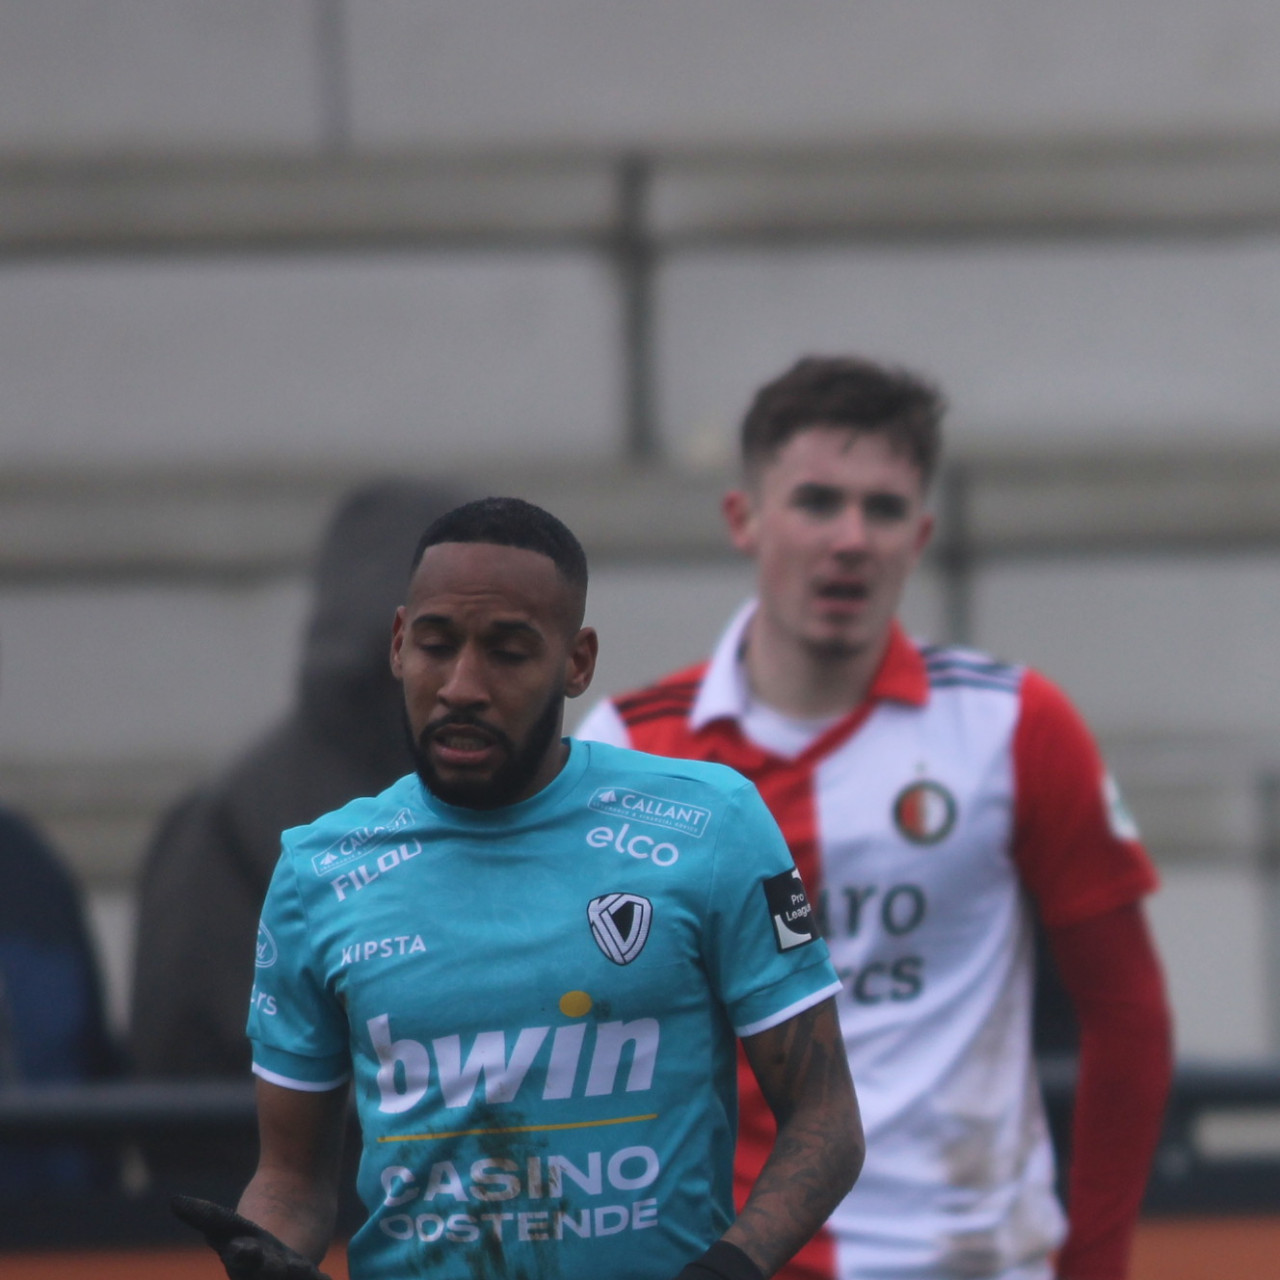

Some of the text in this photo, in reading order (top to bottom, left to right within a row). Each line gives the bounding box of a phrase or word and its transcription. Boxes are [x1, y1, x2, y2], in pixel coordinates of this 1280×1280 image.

[622, 794, 706, 825] CALLANT
[340, 811, 407, 856] CALLT
[586, 823, 679, 867] elco
[330, 838, 422, 902] FILOU
[786, 903, 812, 922] Leagu
[791, 892, 805, 904] Pro
[340, 934, 426, 966] KIPSTA
[366, 989, 660, 1114] bwin
[380, 1146, 660, 1207] CASINO
[379, 1197, 658, 1242] OOSTENDE
